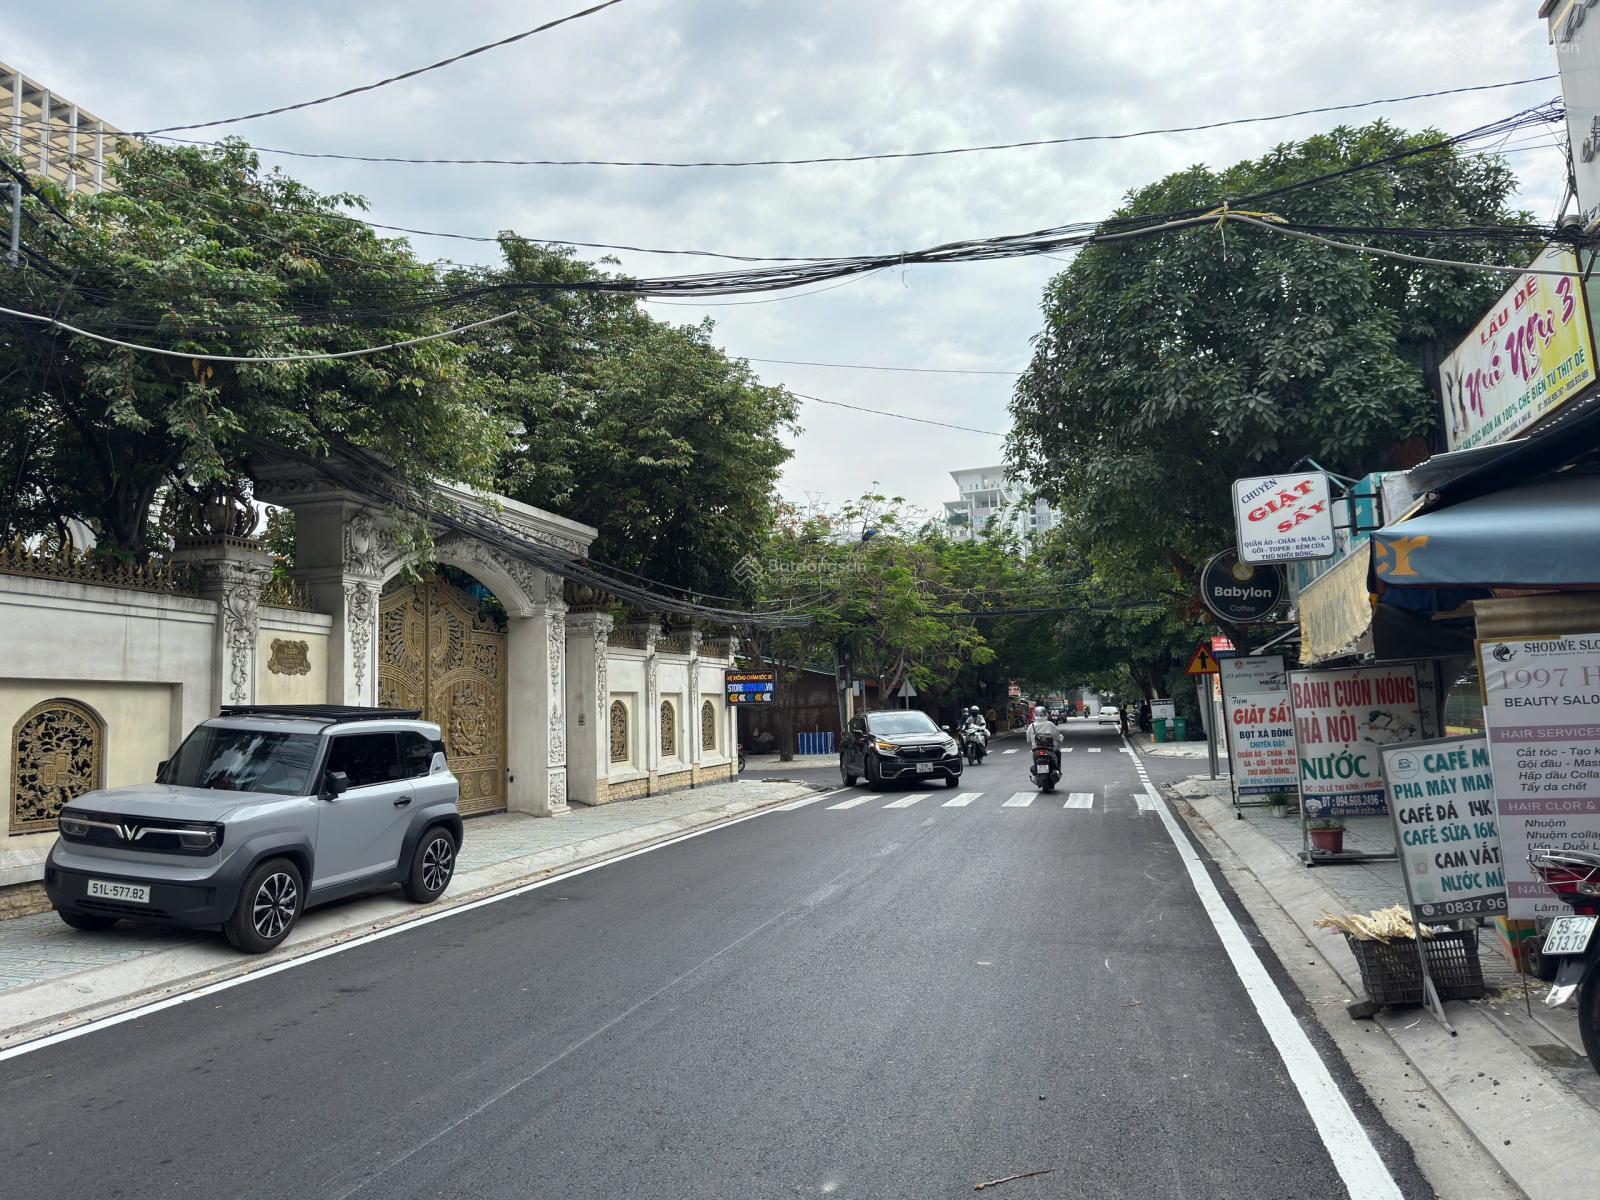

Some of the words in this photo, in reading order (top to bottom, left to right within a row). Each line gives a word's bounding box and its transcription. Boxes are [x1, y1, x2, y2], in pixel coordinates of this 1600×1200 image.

[1514, 275, 1538, 312] DÊ
[1556, 277, 1576, 325] 3
[1241, 478, 1278, 504] CHUYÊN
[1248, 480, 1314, 522] GIẶT
[1277, 500, 1326, 533] SẤY
[1214, 586, 1272, 600] Babylon
[1524, 639, 1576, 653] SHODWE
[1499, 667, 1568, 689] 1997
[1292, 676, 1331, 709] BÁNH
[1334, 671, 1372, 707] CUỐN
[1375, 671, 1416, 705] NÓNG
[1504, 696, 1558, 707] BEAUTY
[1233, 704, 1266, 729] GIẶT
[1298, 711, 1323, 744] HÀ
[1326, 710, 1358, 748] NỘI
[1500, 729, 1533, 739] HAIR
[1424, 745, 1469, 773] CAFÉ
[1540, 748, 1558, 757] tóc
[1569, 747, 1591, 757] Tạo
[1300, 750, 1370, 780] NƯỚC
[1517, 760, 1537, 769] Gội
[1519, 771, 1542, 782] Hấp
[1543, 782, 1560, 791] da
[1561, 781, 1587, 791] chết
[1393, 782, 1423, 800] PHA
[1426, 776, 1457, 796] MÁY
[1399, 803, 1435, 825] CAFÉ
[1437, 801, 1459, 821] ĐÁ
[1468, 800, 1493, 817] 14K
[1508, 801, 1541, 811] HAIR
[1545, 801, 1581, 811] CLOR
[1586, 801, 1595, 810] &
[1403, 825, 1438, 846] CAFÉ
[1441, 823, 1471, 843] SỮA
[1474, 821, 1497, 839] 16K
[1525, 819, 1566, 829] Nhuộm
[1526, 830, 1567, 840] Nhuộm
[1434, 851, 1468, 869] CAM
[1470, 842, 1500, 866] VẮT
[92, 883, 145, 899] 51L-577.82
[1441, 871, 1483, 892] NƯỚC
[1445, 900, 1482, 914] 0837
[1487, 897, 1506, 910] 96
[1534, 902, 1559, 912] Làm
